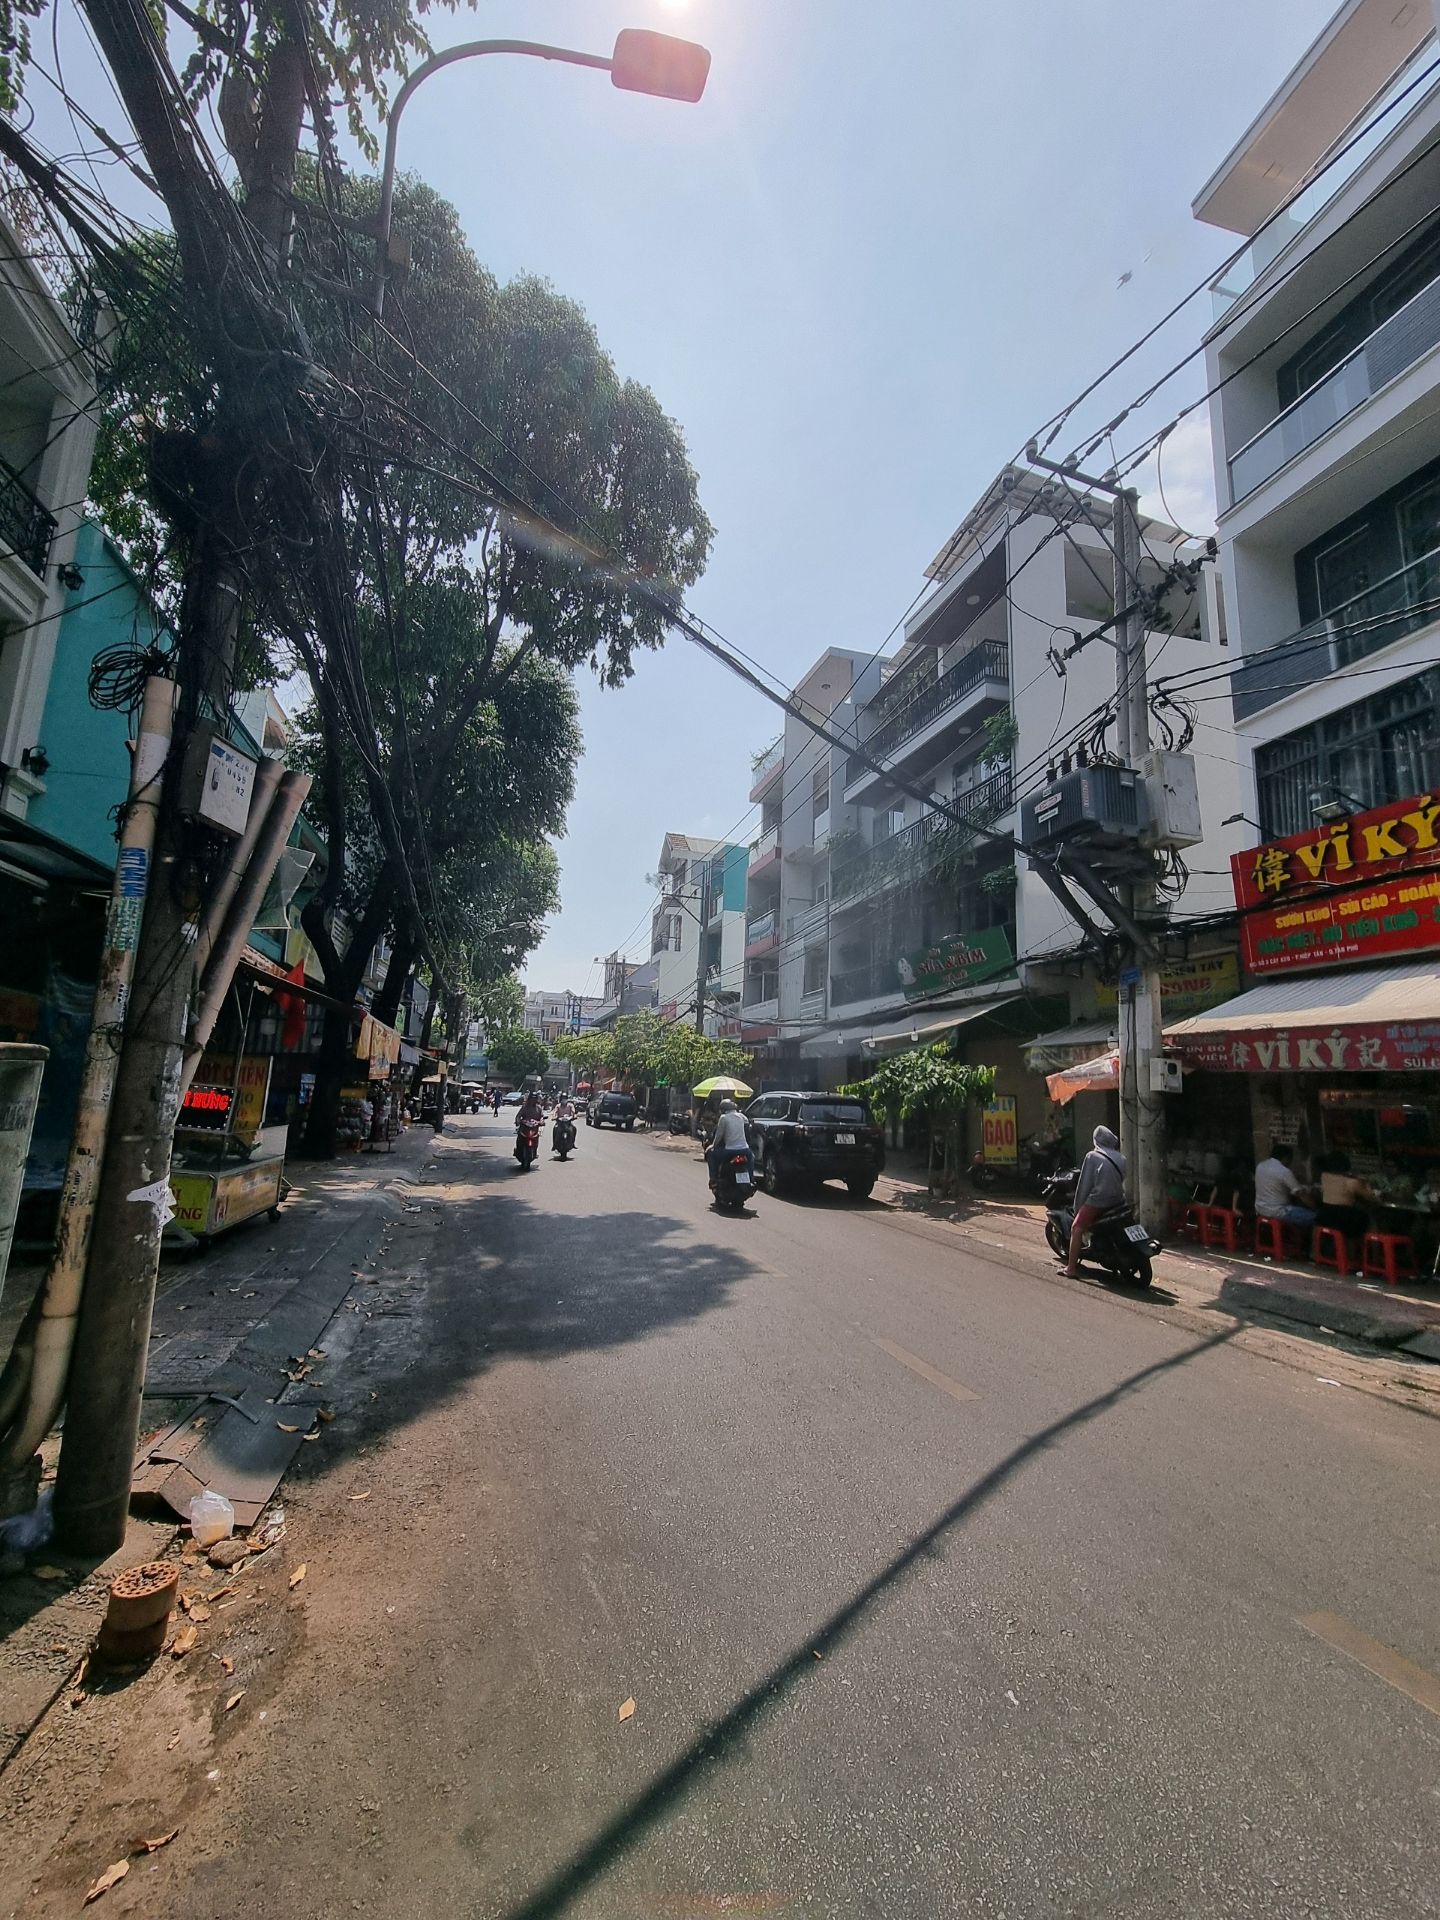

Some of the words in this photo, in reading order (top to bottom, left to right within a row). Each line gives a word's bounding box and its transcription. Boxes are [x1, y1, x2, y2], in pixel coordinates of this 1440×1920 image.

[1295, 822, 1354, 877] VĨ
[1361, 795, 1440, 863] KÝ
[1251, 848, 1292, 893] 偉
[1253, 1032, 1292, 1069] VĨ
[1355, 1035, 1388, 1069] 記
